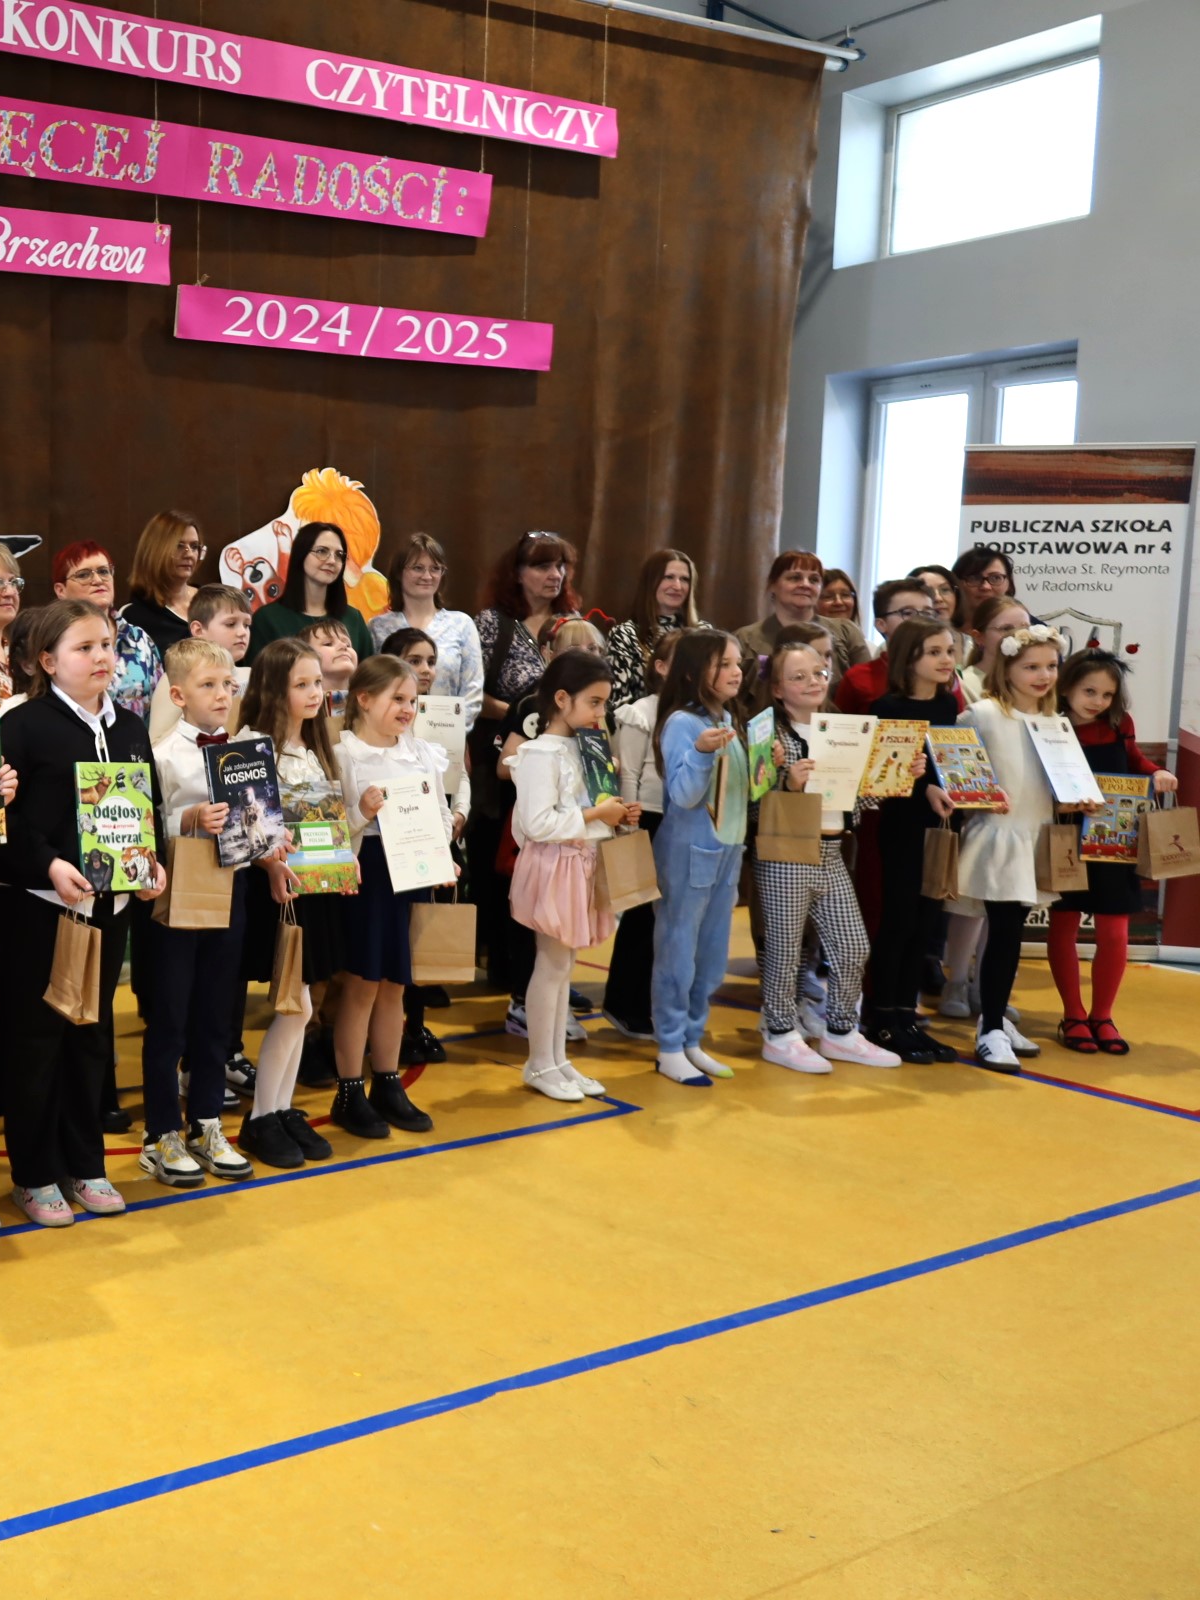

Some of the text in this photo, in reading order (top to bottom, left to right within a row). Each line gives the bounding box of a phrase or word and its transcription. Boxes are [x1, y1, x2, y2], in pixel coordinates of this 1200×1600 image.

[0, 0, 604, 149] KONKURS CZYTELNICZY
[222, 296, 509, 360] 2024/2025
[970, 519, 1173, 533] PUBLICZNA SZKOŁA
[1133, 545, 1155, 554] nr
[1160, 541, 1172, 554] 4
[1012, 563, 1170, 578] adysława St. Reymonta
[1026, 580, 1113, 593] w Radomsku
[223, 759, 265, 773] Jak zdobywamy
[224, 767, 267, 785] KOSMOS
[93, 804, 143, 821] Odgłosy
[96, 831, 143, 845] zwierząt
